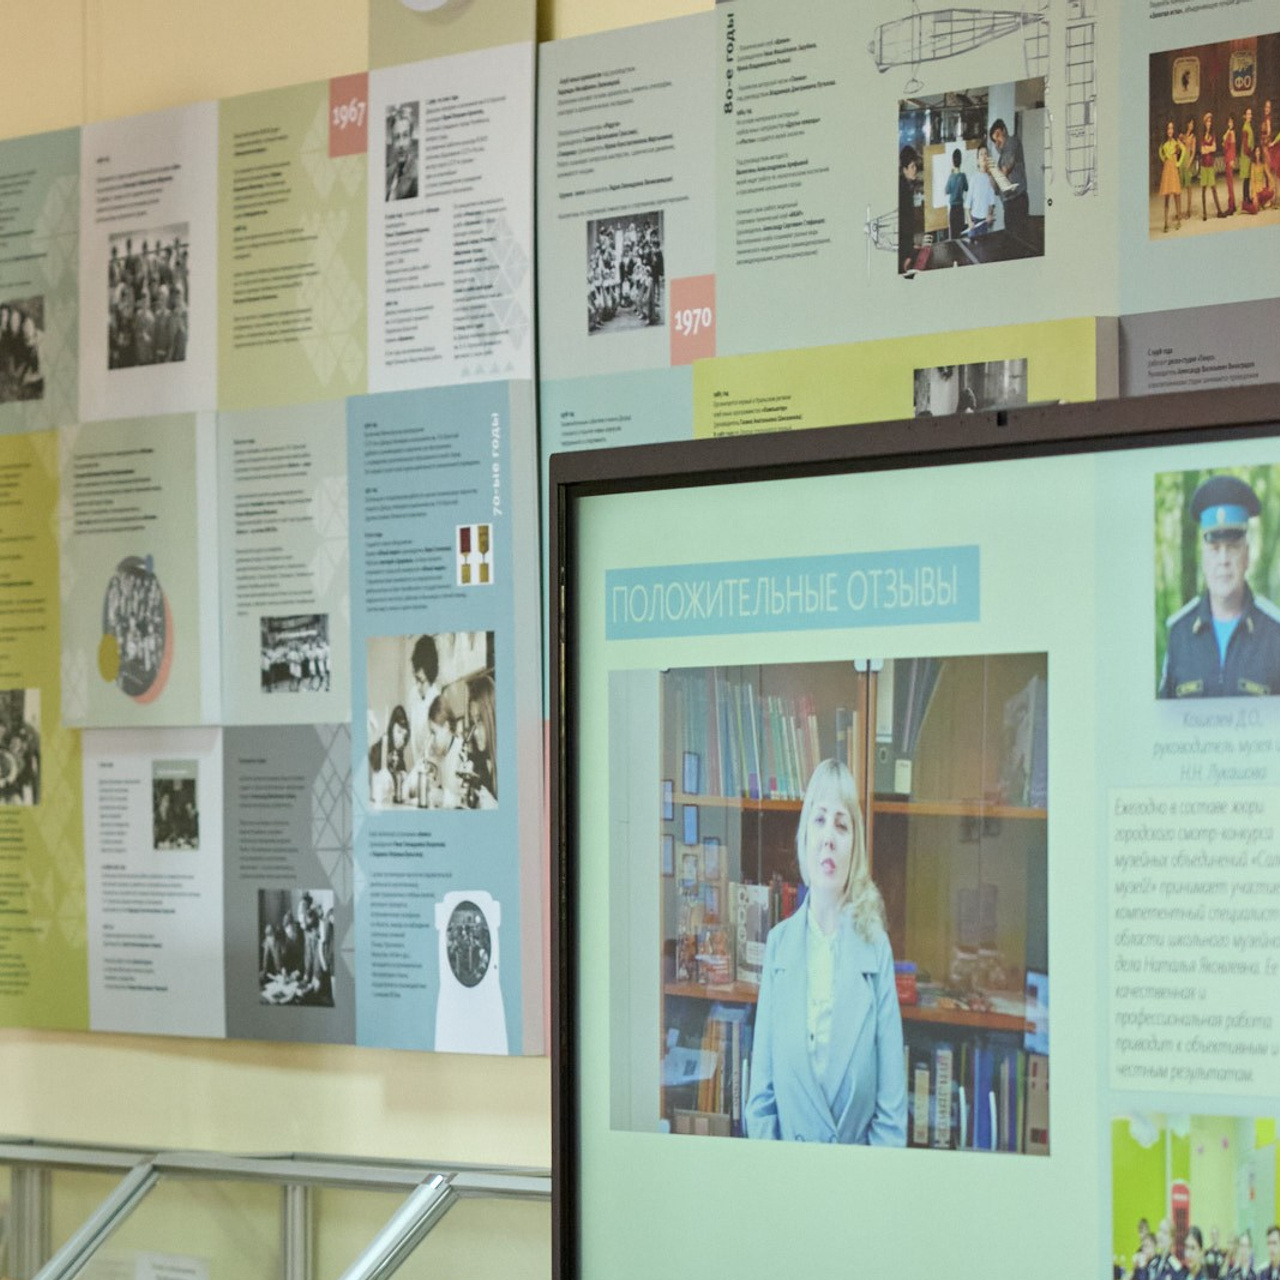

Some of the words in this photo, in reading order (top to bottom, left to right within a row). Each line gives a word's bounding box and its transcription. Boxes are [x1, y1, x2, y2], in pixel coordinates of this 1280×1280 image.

[331, 101, 367, 129] 1967
[674, 306, 712, 334] 1970
[612, 572, 838, 623] ПОЛОЖИТЕЛЬНЫЕ
[847, 564, 958, 612] ОТЗЫВЫ
